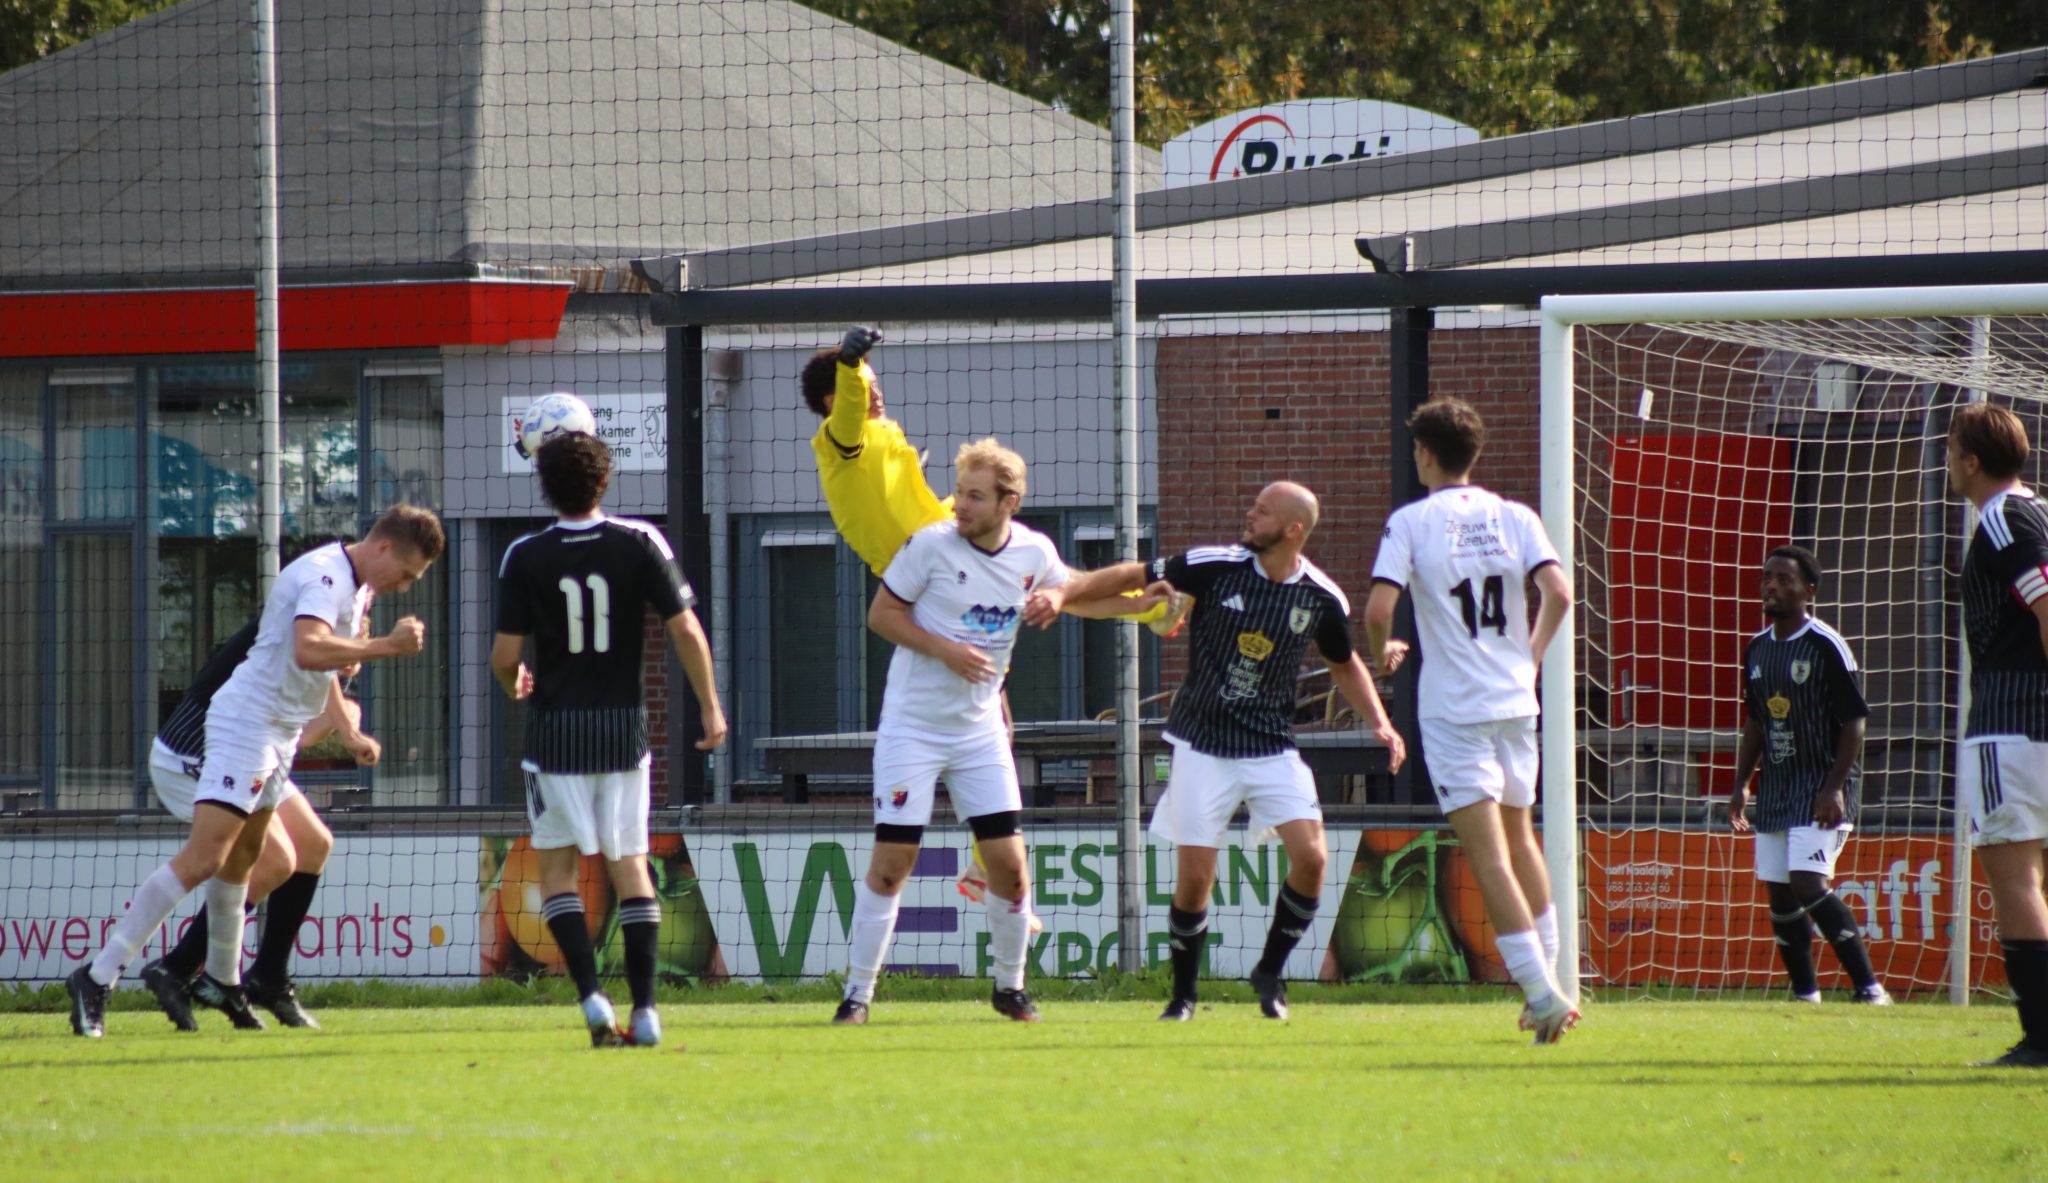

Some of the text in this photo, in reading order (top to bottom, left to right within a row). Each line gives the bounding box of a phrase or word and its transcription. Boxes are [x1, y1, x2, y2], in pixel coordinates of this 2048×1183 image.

[591, 407, 612, 421] ang
[595, 424, 637, 438] skamer
[609, 446, 632, 458] ome
[1456, 534, 1499, 548] Zeeuw
[558, 572, 610, 654] 11
[1450, 575, 1507, 639] 14
[1026, 843, 1291, 907] ESLN
[1813, 860, 1942, 939] aff
[239, 902, 414, 976] ants
